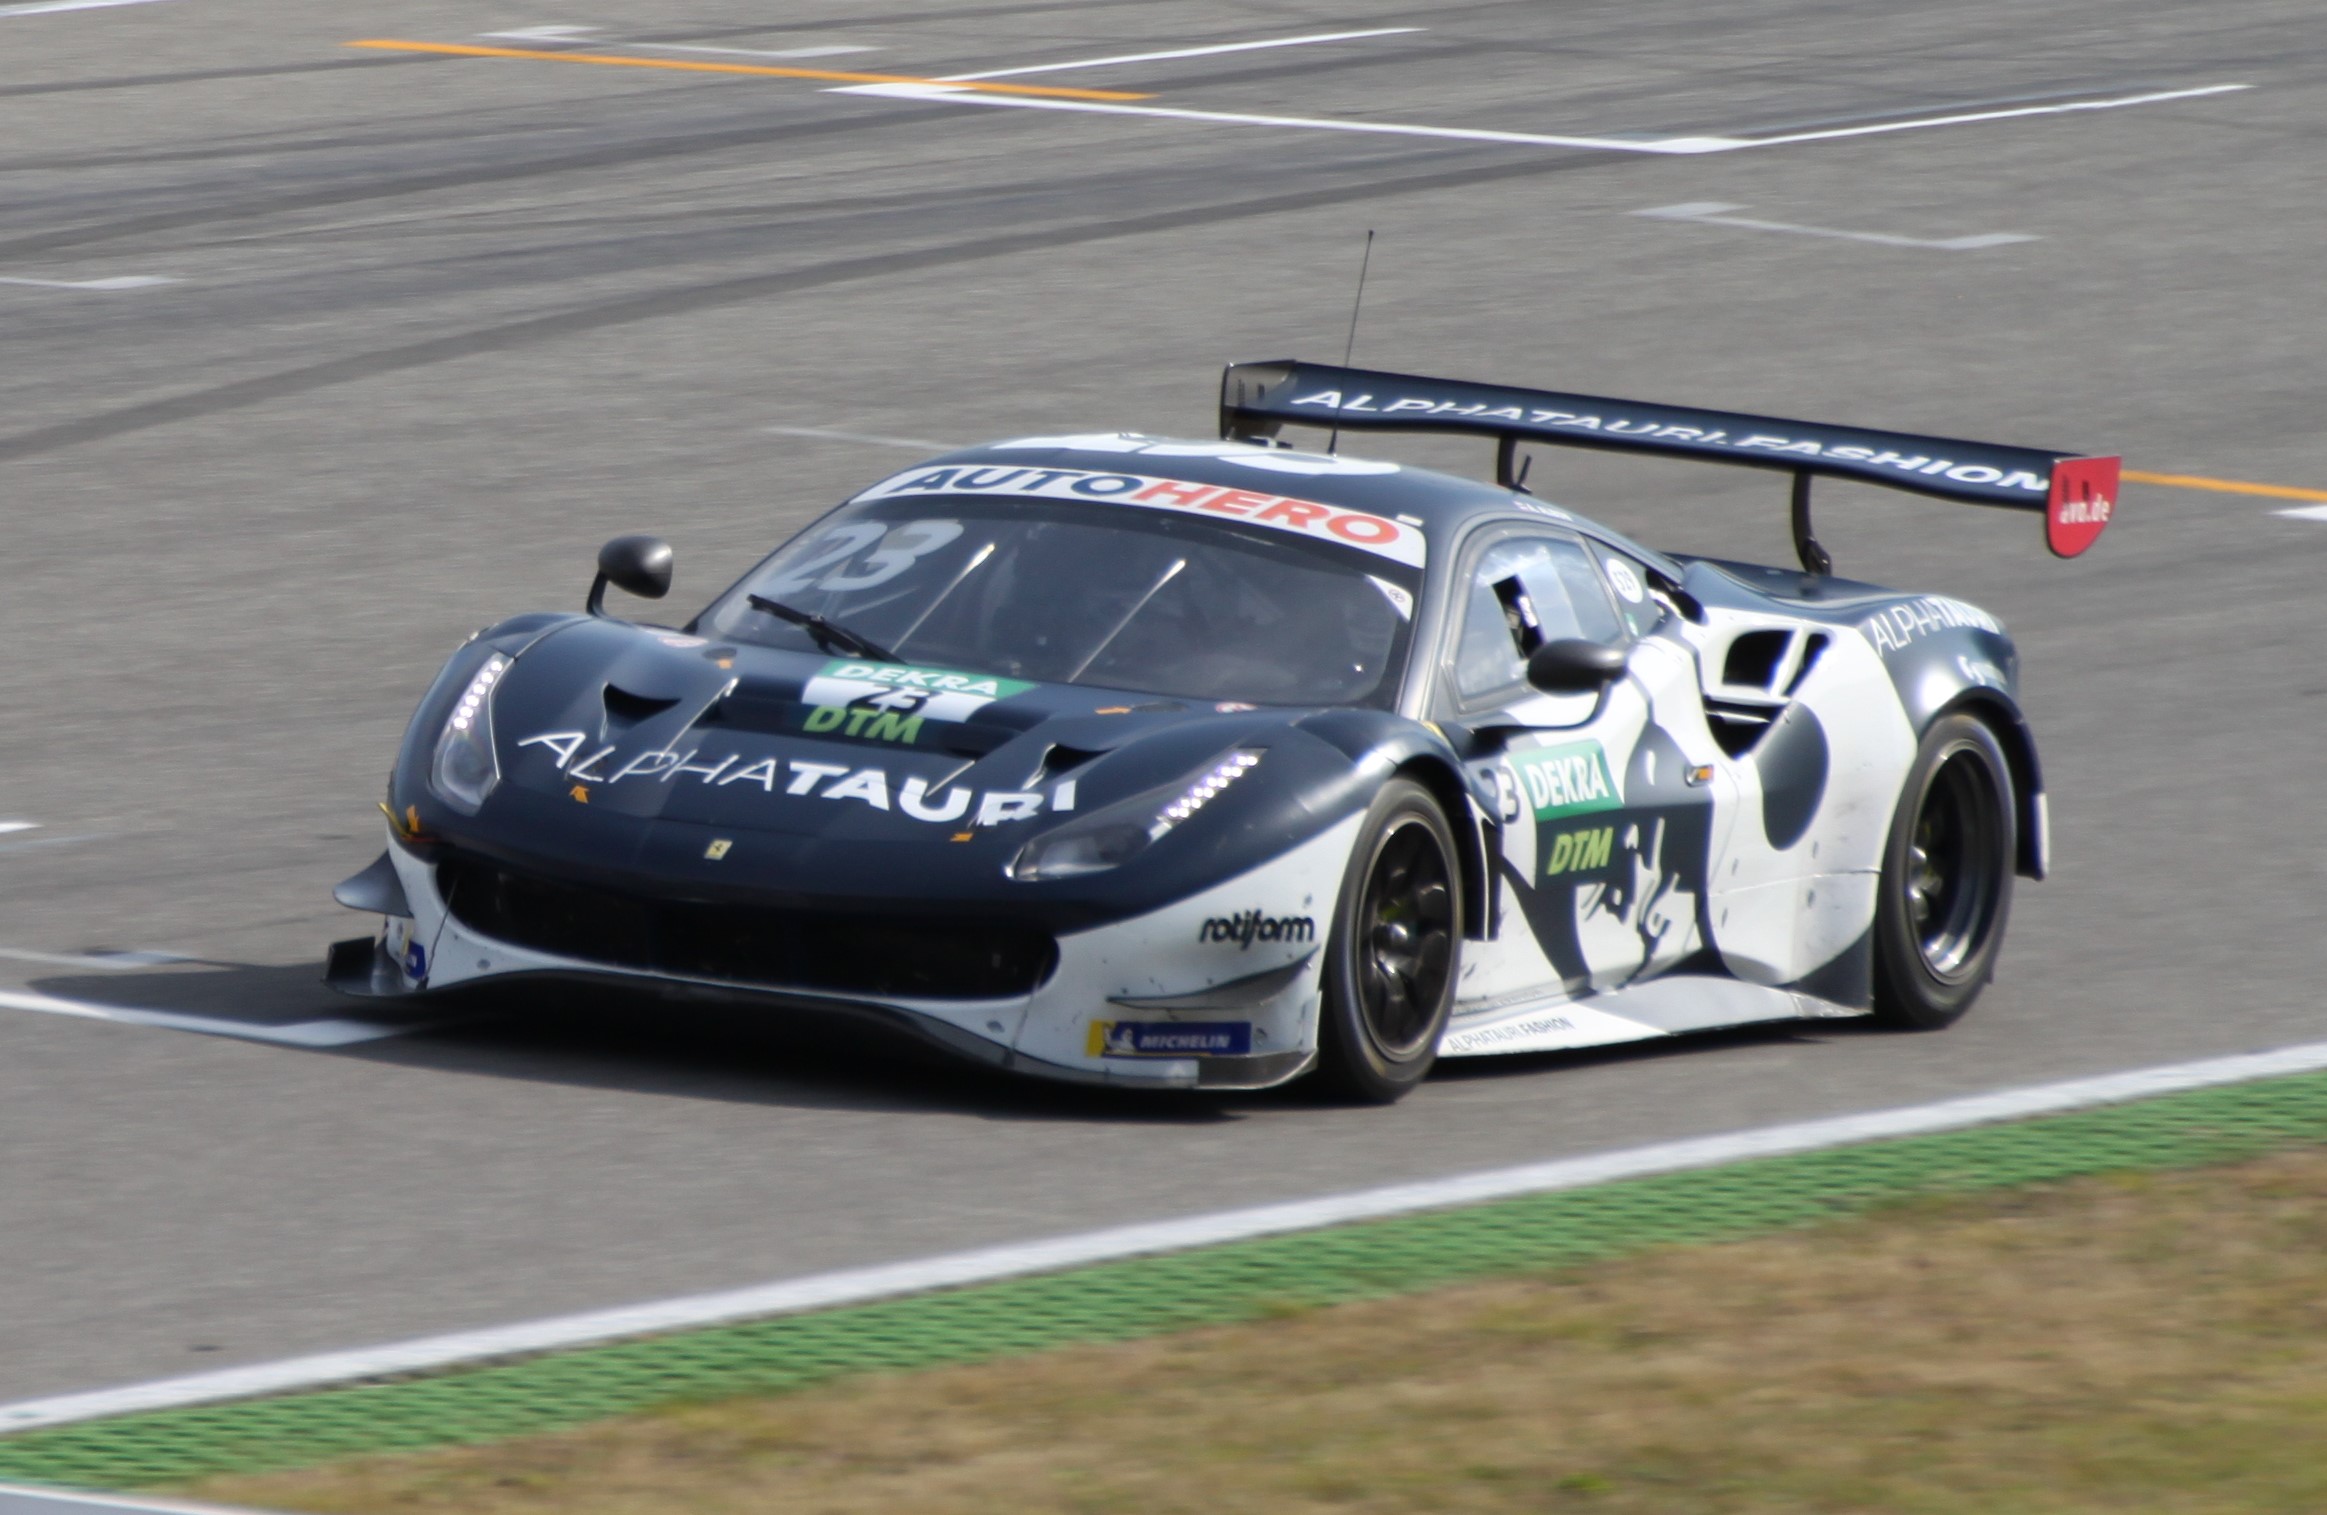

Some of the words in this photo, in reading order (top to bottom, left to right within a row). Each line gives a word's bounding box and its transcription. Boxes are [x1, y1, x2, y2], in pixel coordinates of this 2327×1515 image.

[884, 467, 1400, 544] AUTOHERO
[757, 519, 964, 596] 23
[833, 665, 998, 695] DEKRA
[802, 705, 926, 745] DTM
[518, 730, 1077, 826] ALPHATAURI
[1524, 752, 1610, 810] DEKRA
[1547, 827, 1614, 876] DTM
[1199, 909, 1314, 950] rotiform
[1140, 1033, 1231, 1048] MICHELIN
